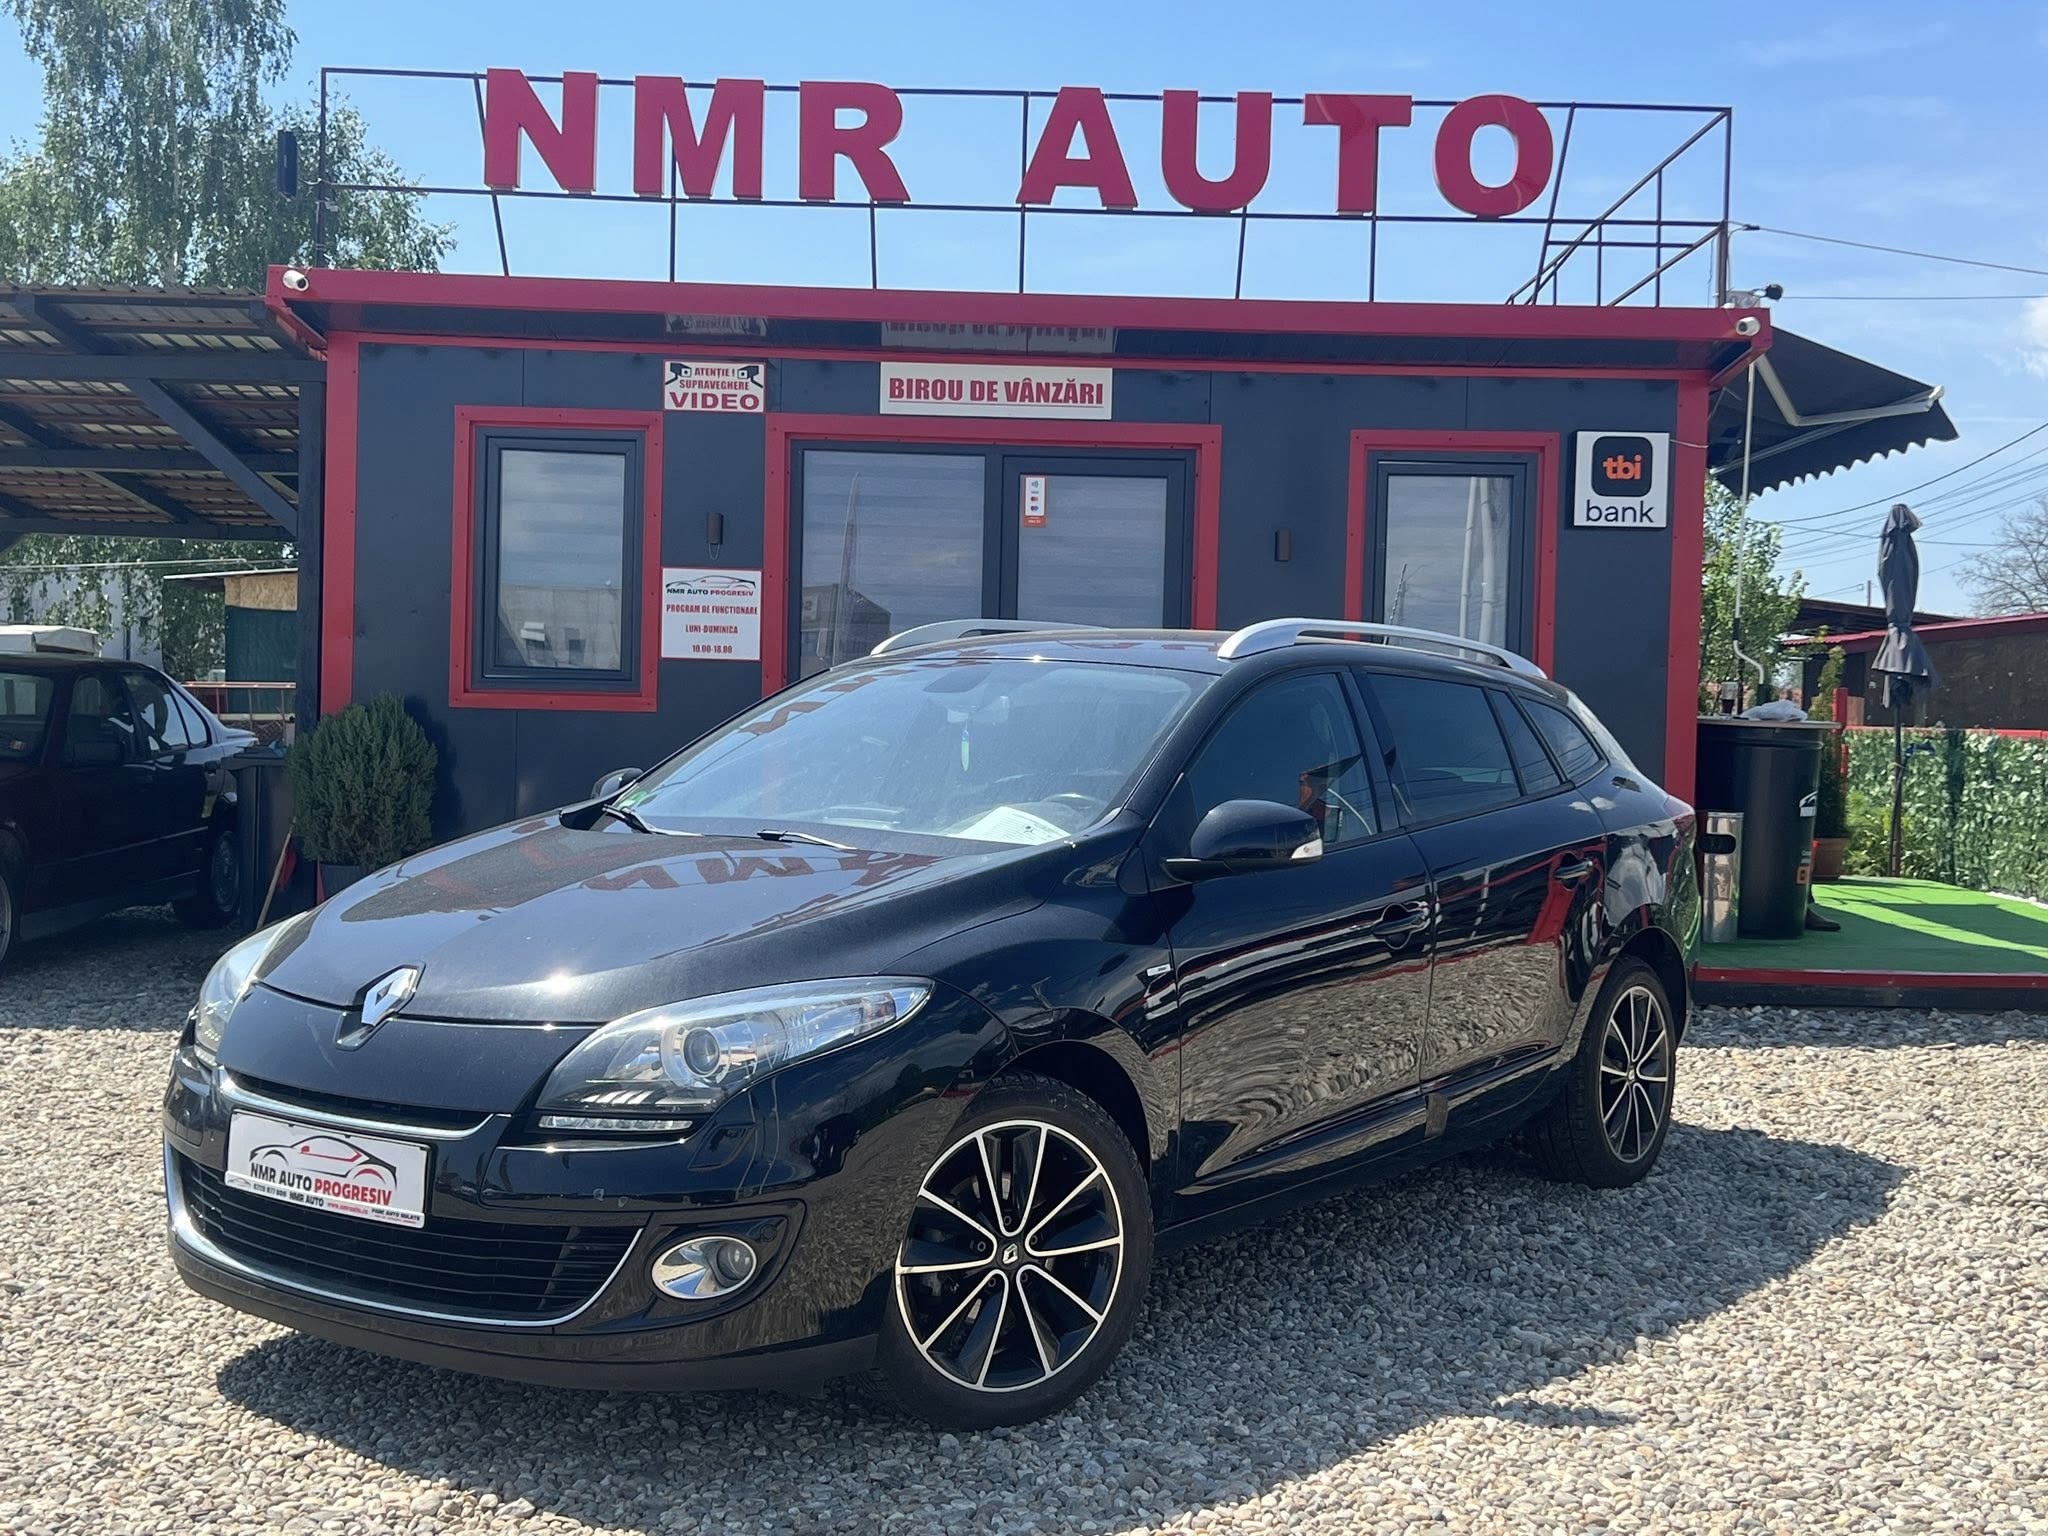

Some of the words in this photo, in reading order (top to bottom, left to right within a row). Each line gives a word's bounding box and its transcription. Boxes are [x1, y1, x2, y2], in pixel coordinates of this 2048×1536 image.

[483, 67, 911, 204] NMR
[1016, 85, 1555, 218] AUTO
[679, 379, 750, 390] SUPRAVEGHERE
[889, 377, 963, 401] BIROU
[970, 380, 998, 402] DE
[1004, 377, 1104, 405] VÂNZĂRI
[669, 391, 759, 410] VIDEO
[1602, 454, 1642, 480] tbi
[1586, 499, 1655, 523] bank
[687, 588, 709, 596] AUTO
[710, 589, 754, 597] PROGRESIV
[666, 603, 700, 613] PROGRAM
[701, 604, 710, 613] DE
[250, 1162, 276, 1182] NMR
[279, 1170, 312, 1191] AUTO
[314, 1178, 393, 1206] PROGRESIV
[305, 1194, 324, 1207] AUTO
